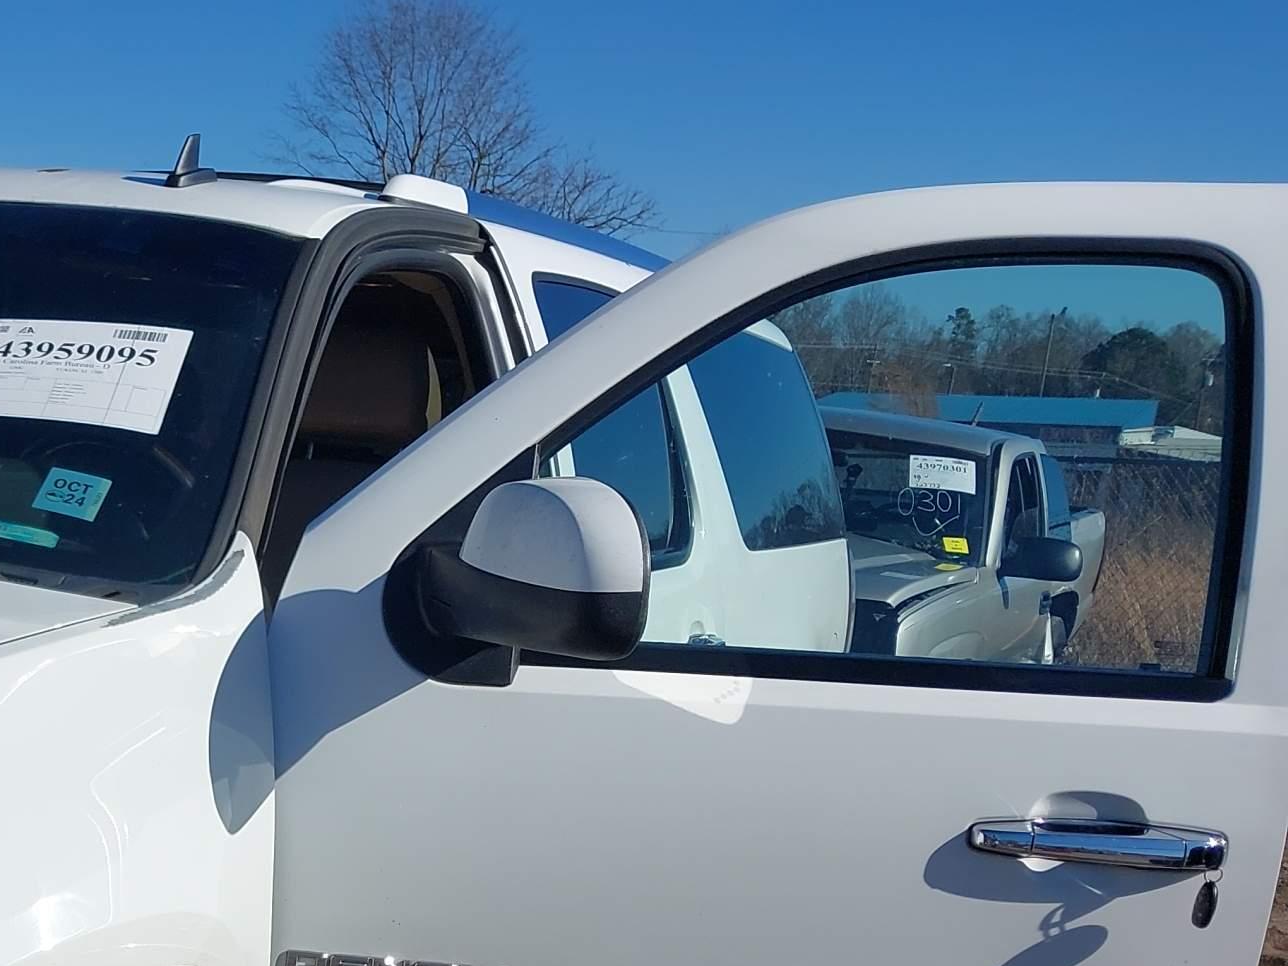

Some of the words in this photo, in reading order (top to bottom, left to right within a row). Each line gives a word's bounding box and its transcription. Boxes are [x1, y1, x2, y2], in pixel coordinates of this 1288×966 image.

[54, 478, 94, 495] OCT
[63, 493, 87, 507] 24
[898, 488, 961, 515] 0301
